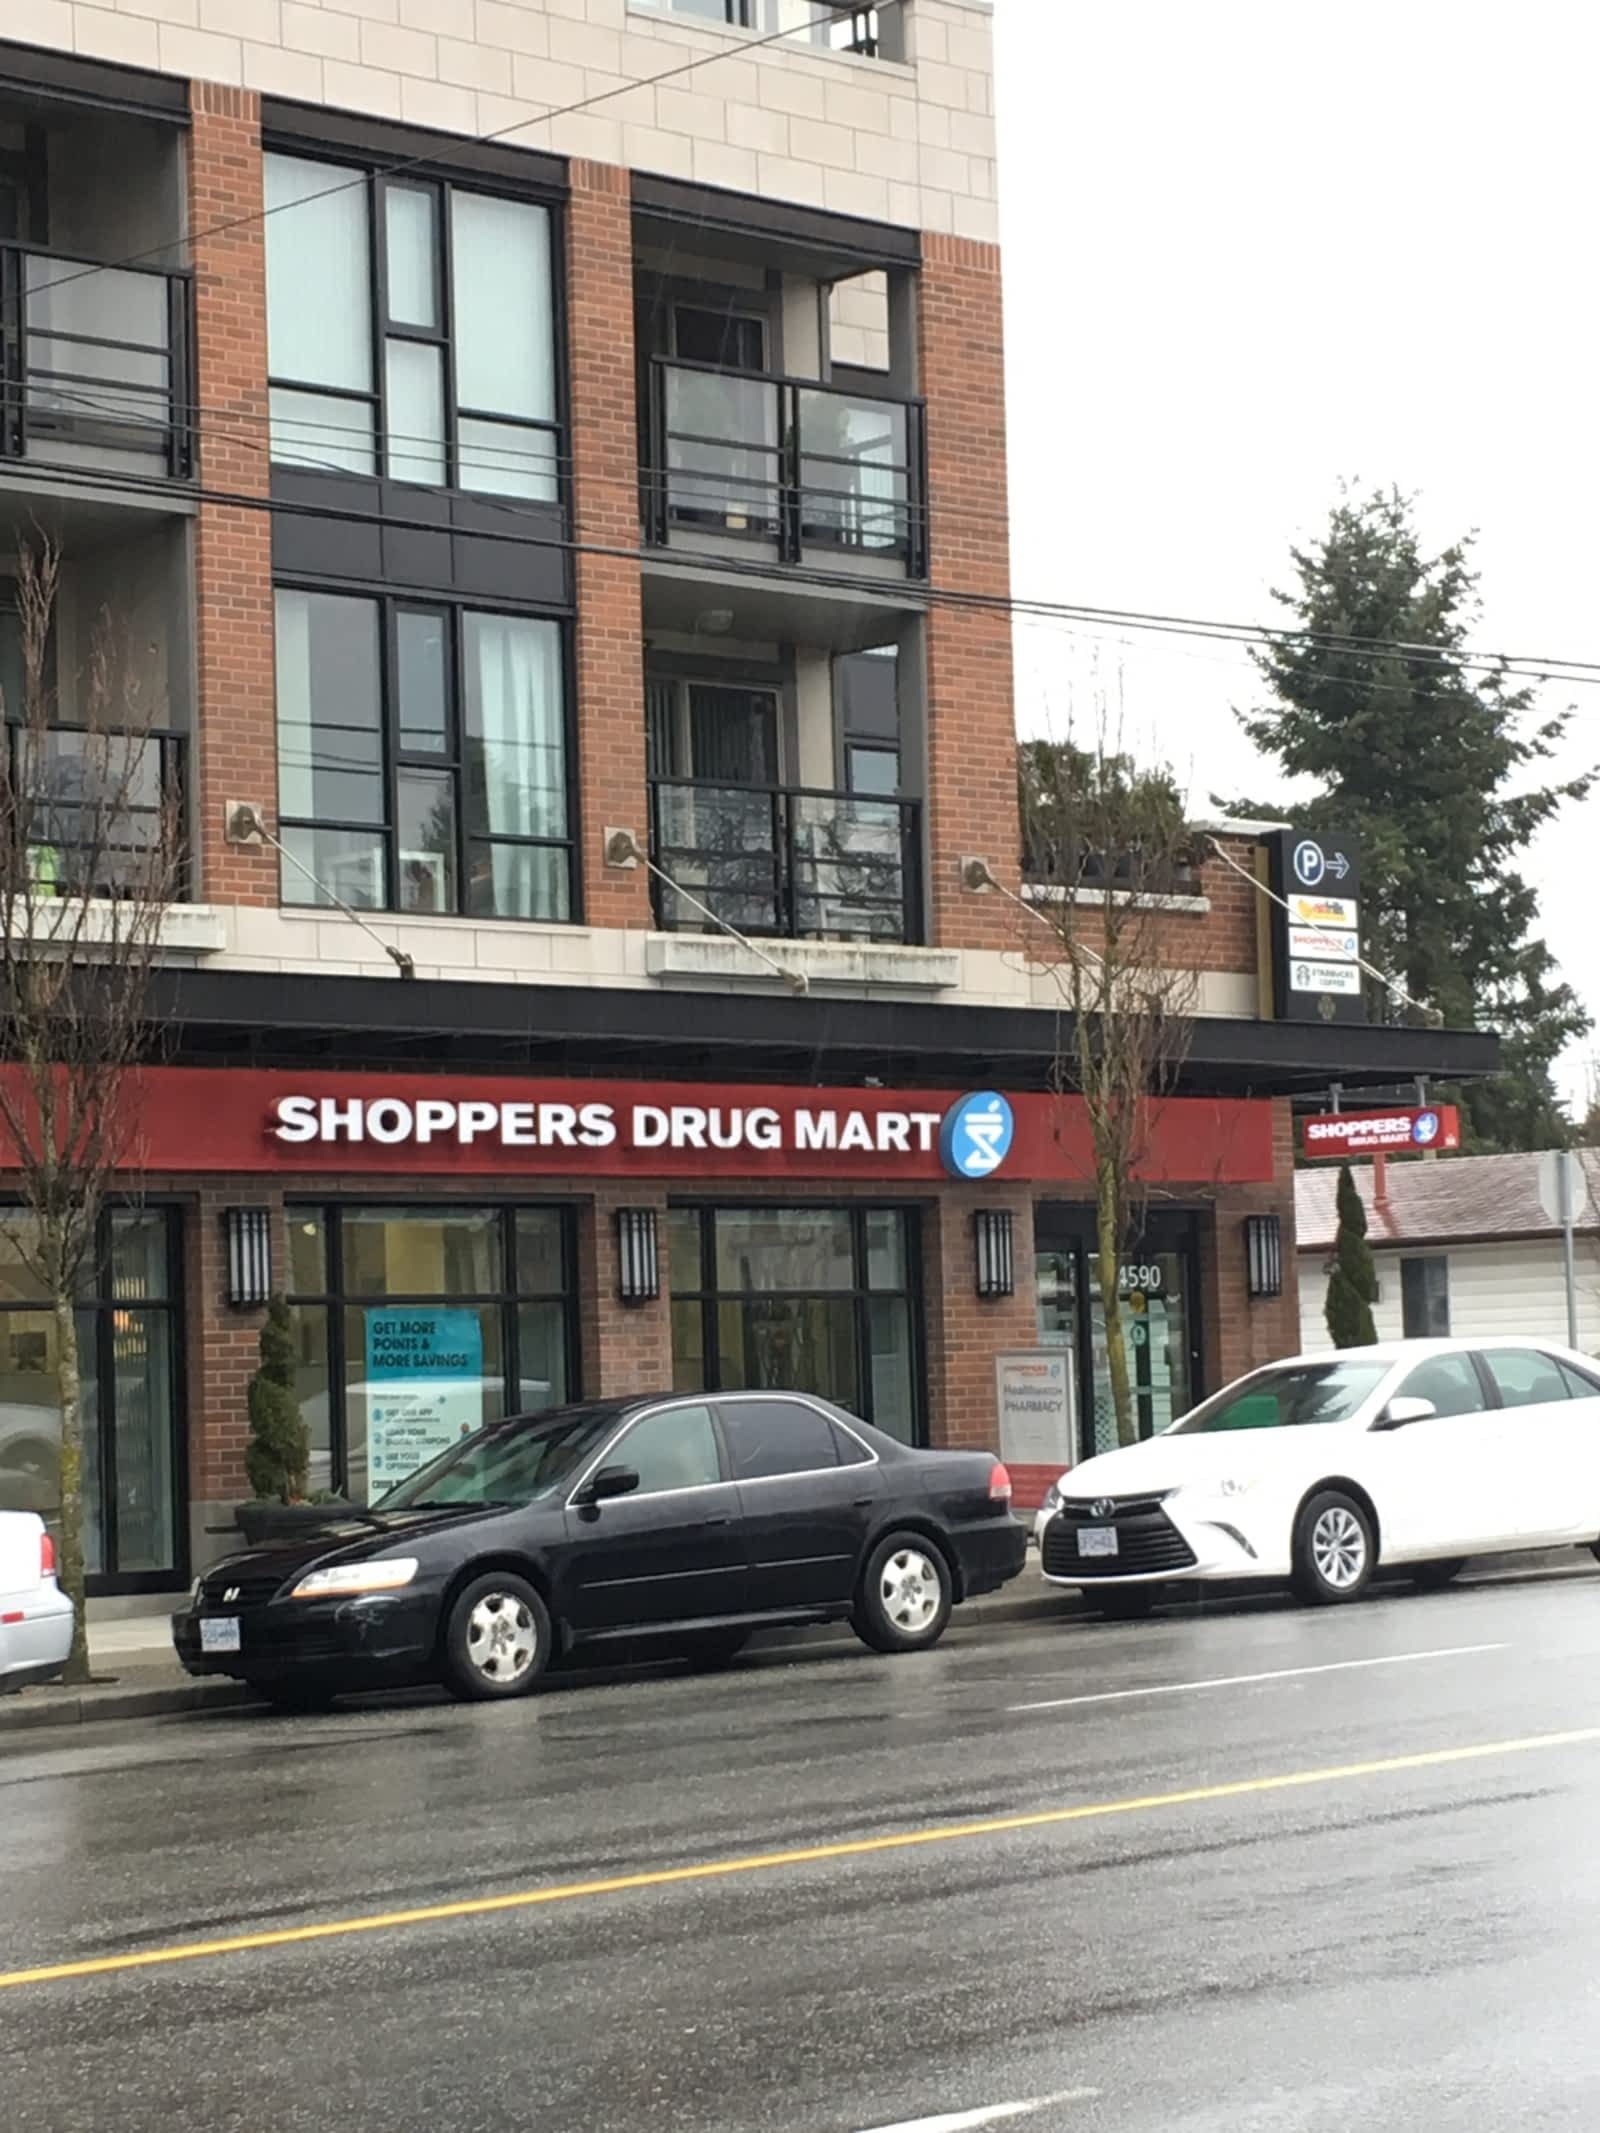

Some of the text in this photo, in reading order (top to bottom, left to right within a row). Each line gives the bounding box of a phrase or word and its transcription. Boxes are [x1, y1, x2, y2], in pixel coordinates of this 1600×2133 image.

[1303, 850, 1318, 877] P
[275, 1095, 941, 1151] SHOPPERS DRUG MART
[1308, 1117, 1411, 1139] SHOPPERS
[1347, 1133, 1411, 1146] DRUG MART
[1119, 1264, 1161, 1288] 4590
[373, 1321, 436, 1334] GET MORE
[373, 1338, 431, 1350] POINTS &
[372, 1354, 469, 1367] MORE SAVINGS
[1004, 1400, 1063, 1412] PHARMACY
